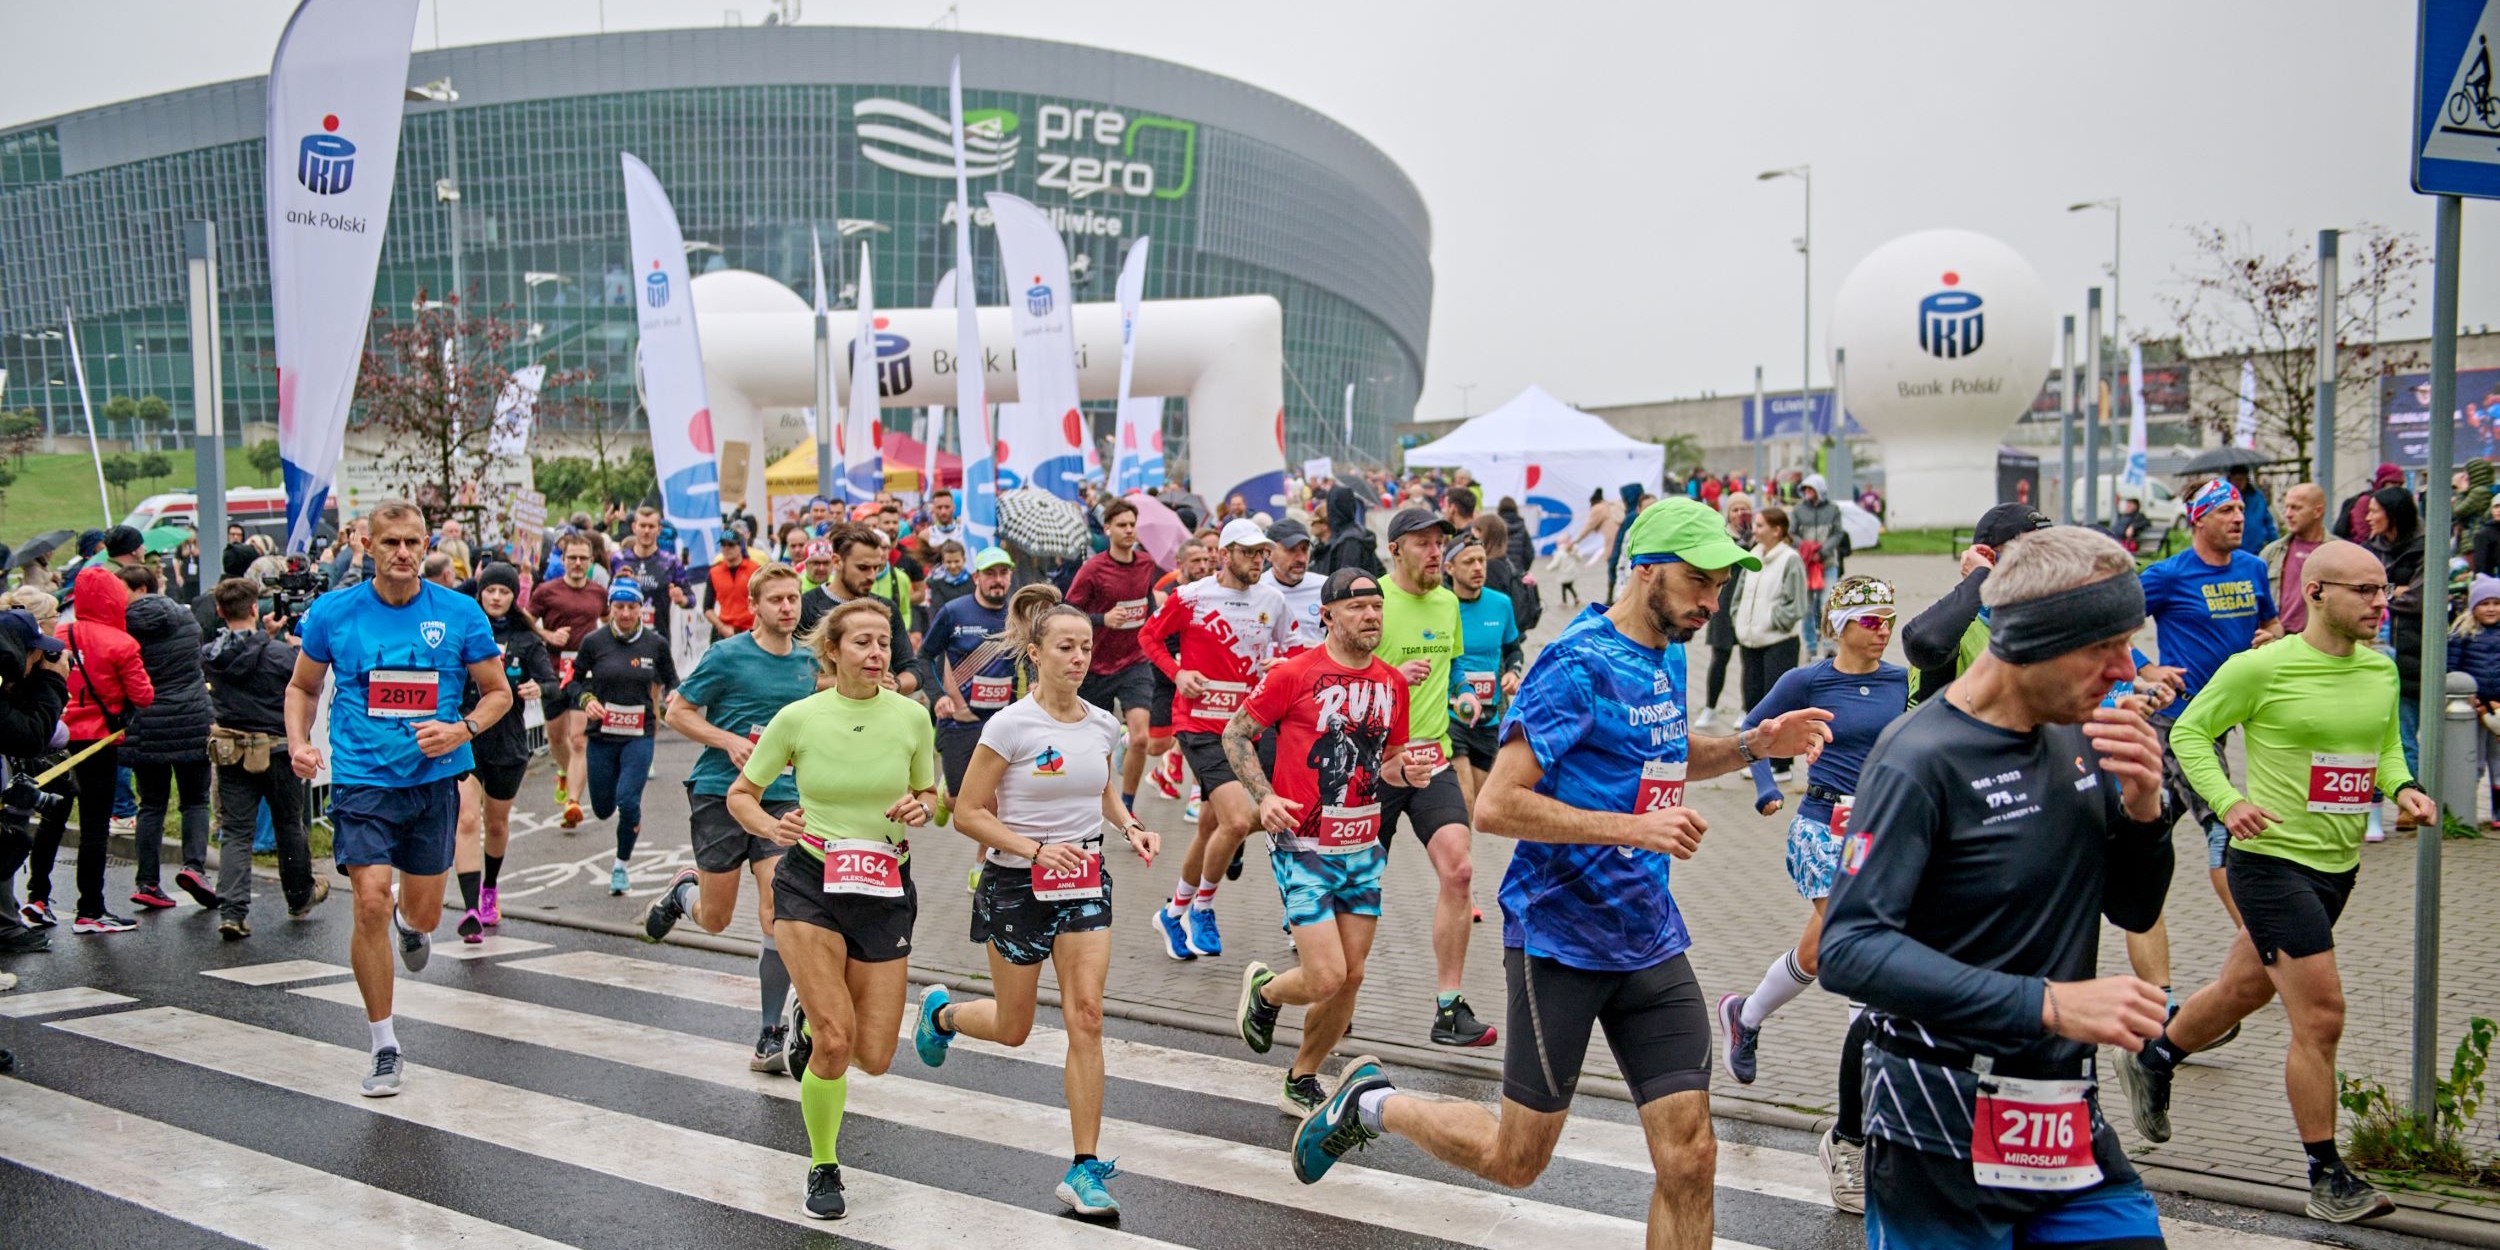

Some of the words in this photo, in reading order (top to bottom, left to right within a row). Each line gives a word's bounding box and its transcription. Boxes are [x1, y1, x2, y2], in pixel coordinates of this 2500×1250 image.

[1038, 105, 1125, 148] pre
[1036, 153, 1154, 196] zero
[287, 209, 317, 226] ank
[320, 211, 367, 234] Polski
[1040, 208, 1122, 236] liwice
[1898, 381, 1943, 397] Bank
[1951, 376, 2002, 394] Polski
[1402, 647, 1421, 655] TEAM
[380, 688, 427, 705] 2817
[977, 685, 1008, 697] 2559
[1200, 691, 1237, 706] 2431
[1314, 675, 1392, 732] RUN
[608, 712, 639, 725] 2265
[2323, 771, 2371, 793] 2616
[1986, 790, 2013, 808] 175
[1331, 819, 1372, 838] 2671
[836, 854, 889, 878] 2164
[840, 874, 886, 887] ALEKSANDRA
[1998, 1109, 2074, 1149] 2116
[2004, 1152, 2068, 1167] MIROSŁAW
